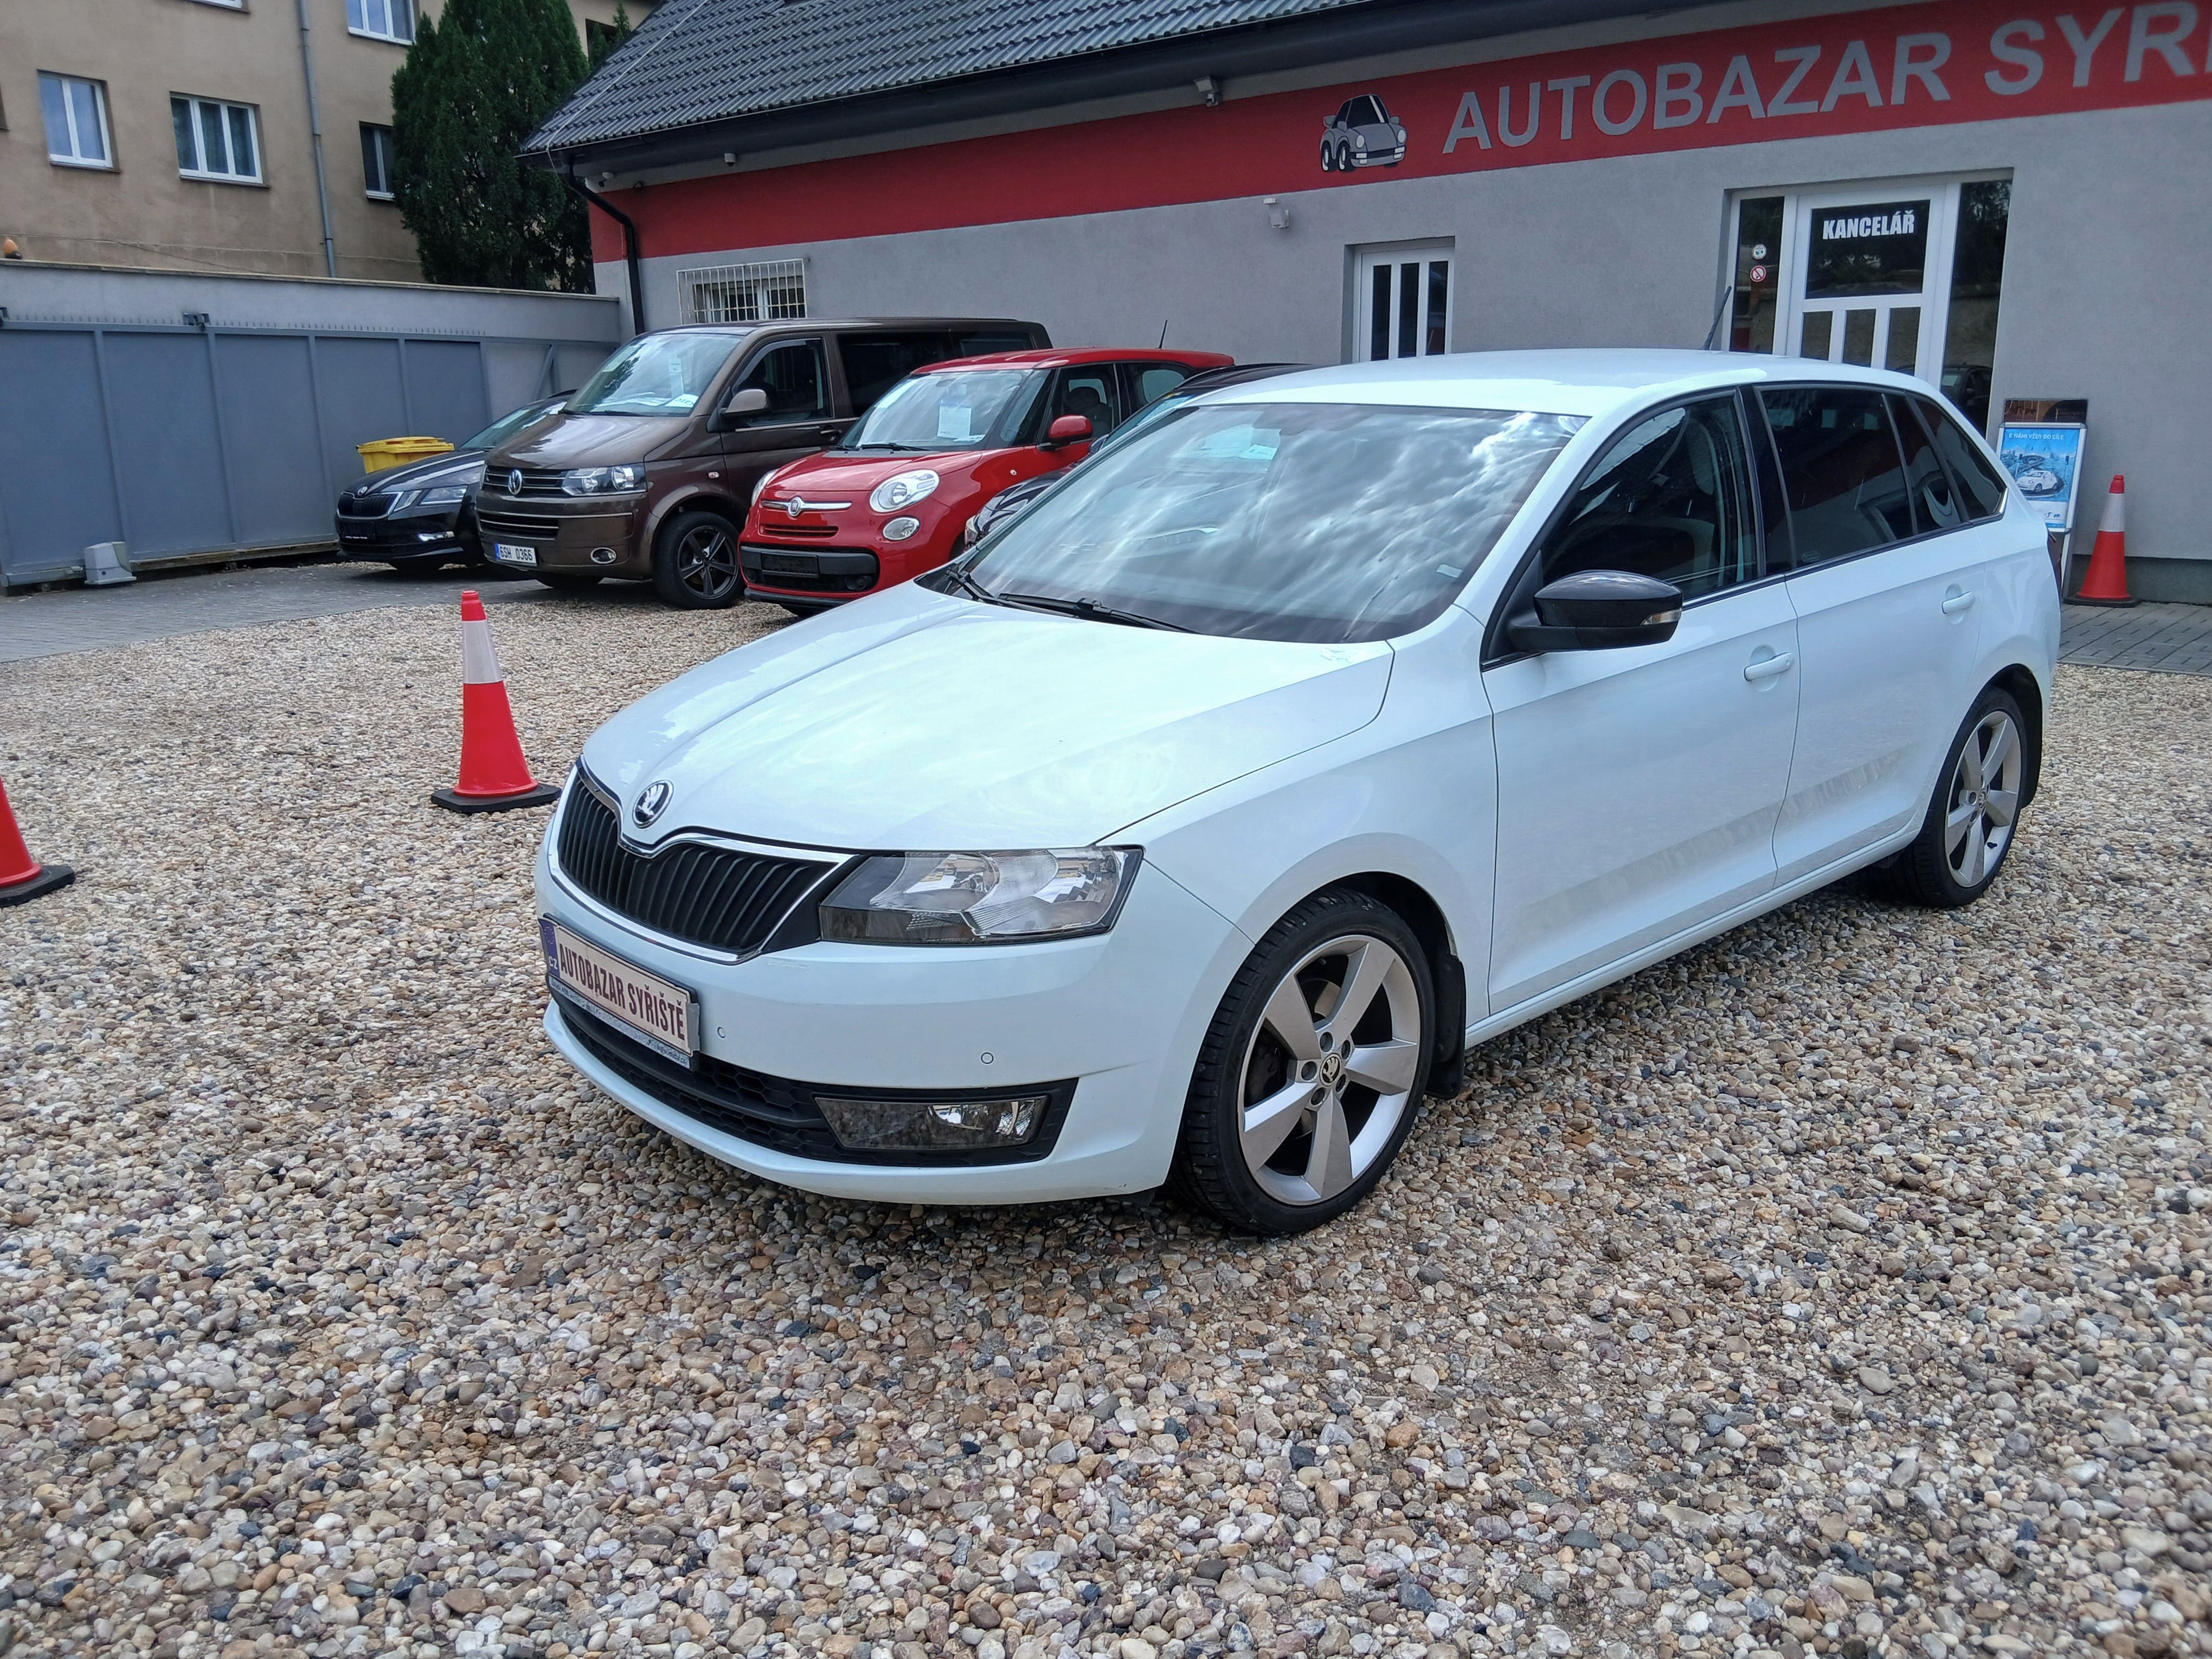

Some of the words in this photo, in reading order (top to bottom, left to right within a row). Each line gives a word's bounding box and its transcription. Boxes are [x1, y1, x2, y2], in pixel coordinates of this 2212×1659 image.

[1442, 31, 1952, 155] AUTOBAZAR
[1822, 209, 1915, 240] KANCELÁŘ
[500, 546, 512, 559] 6SH
[516, 548, 533, 561] 0366
[549, 956, 558, 970] CZ
[559, 943, 626, 1009] AUTOBAZAR
[627, 983, 685, 1041] SYŘIŠTĚ
